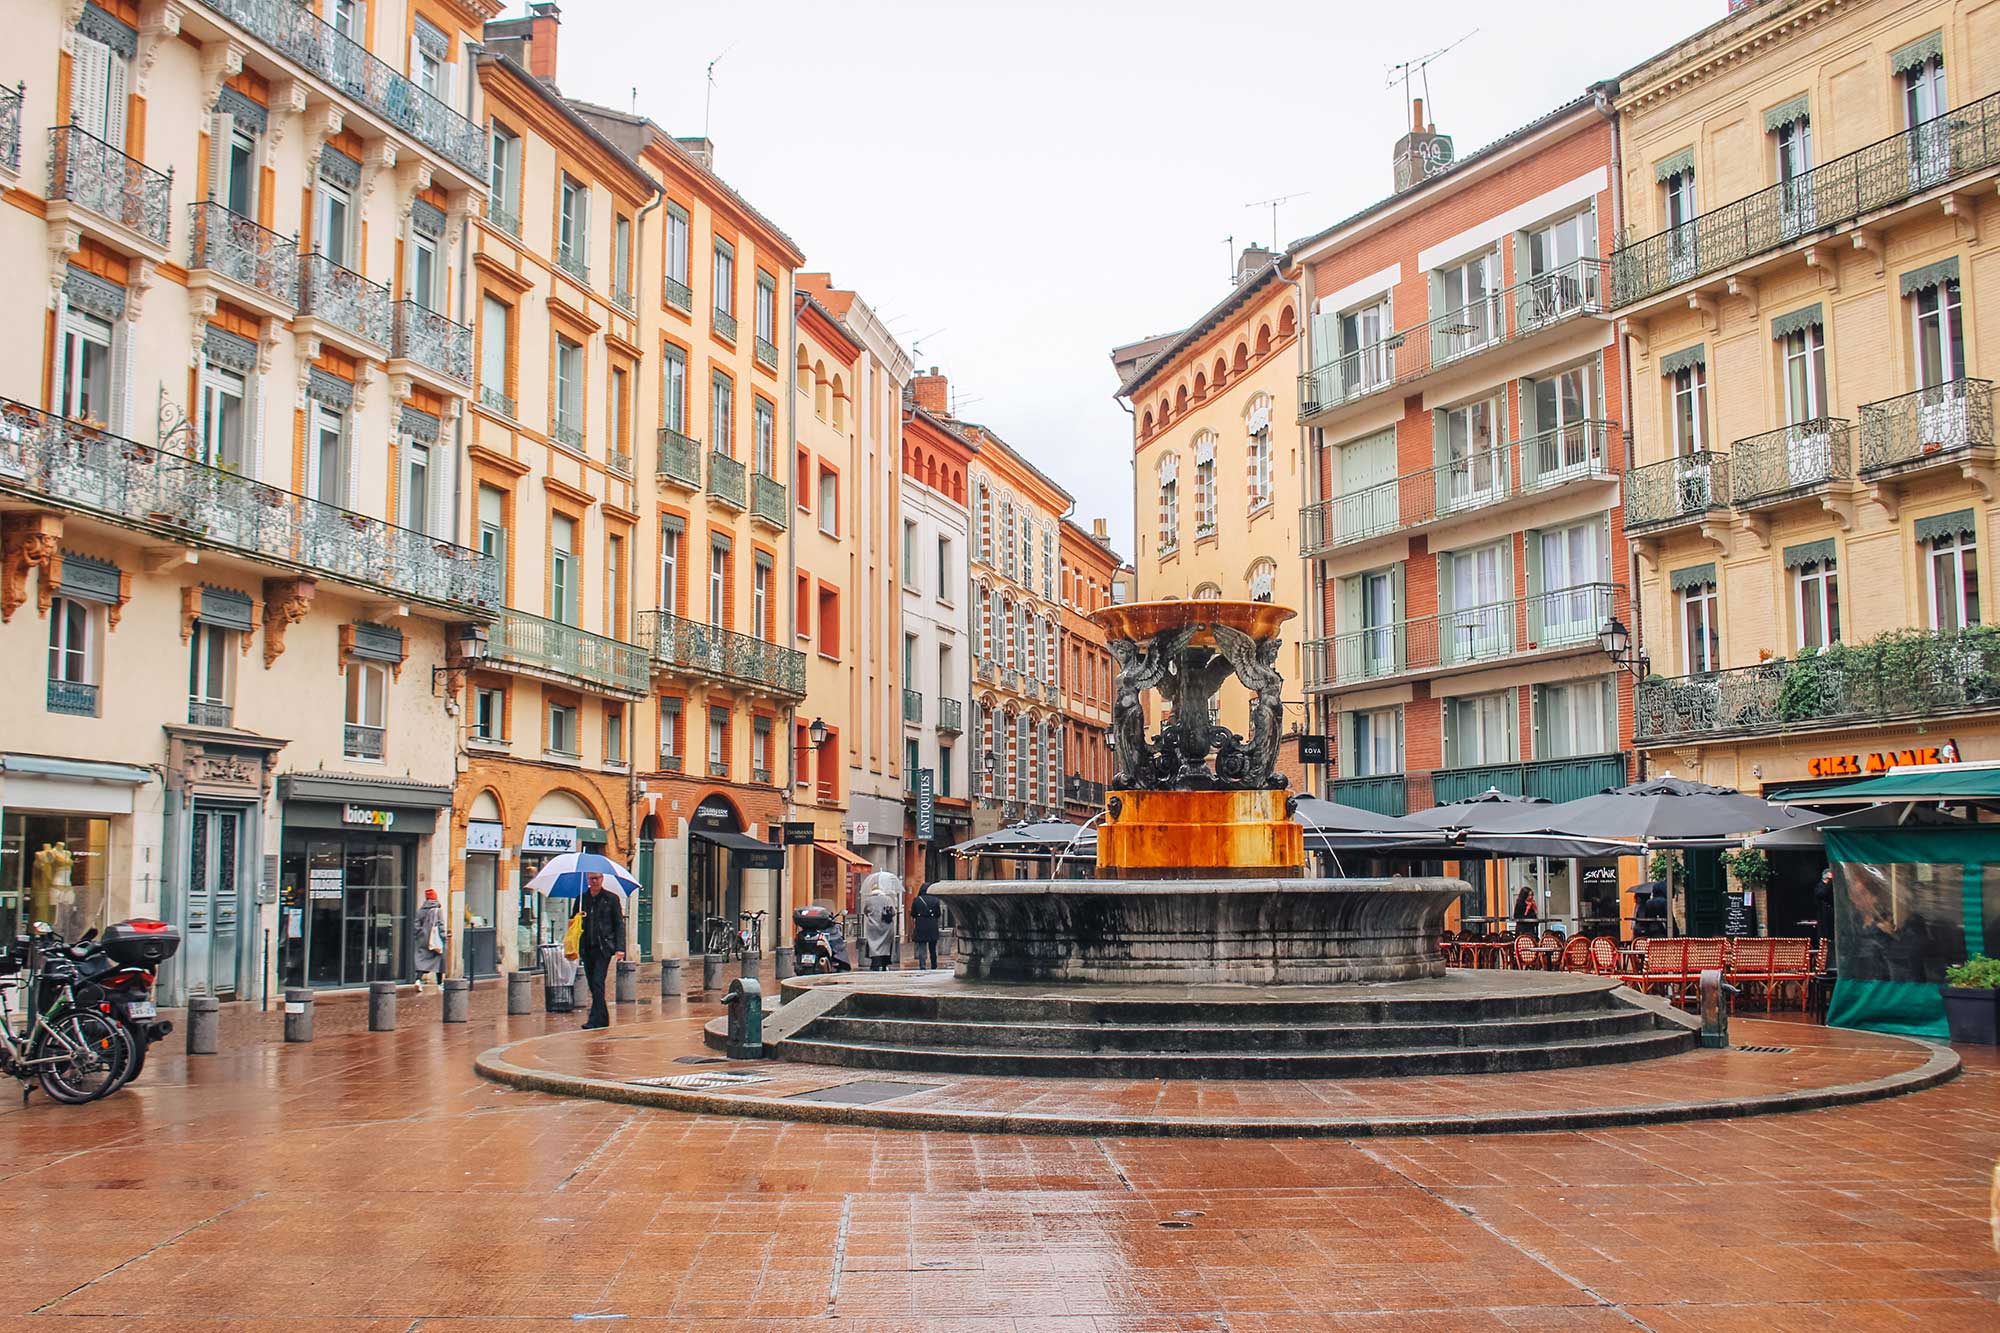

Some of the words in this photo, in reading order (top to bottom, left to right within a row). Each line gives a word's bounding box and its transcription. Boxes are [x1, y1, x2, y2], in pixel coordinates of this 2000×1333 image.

[1807, 755, 1860, 777] CHEZ
[1865, 748, 1940, 772] MAMIE
[343, 803, 394, 831] biocoop
[920, 775, 931, 833] ANTIQUITES
